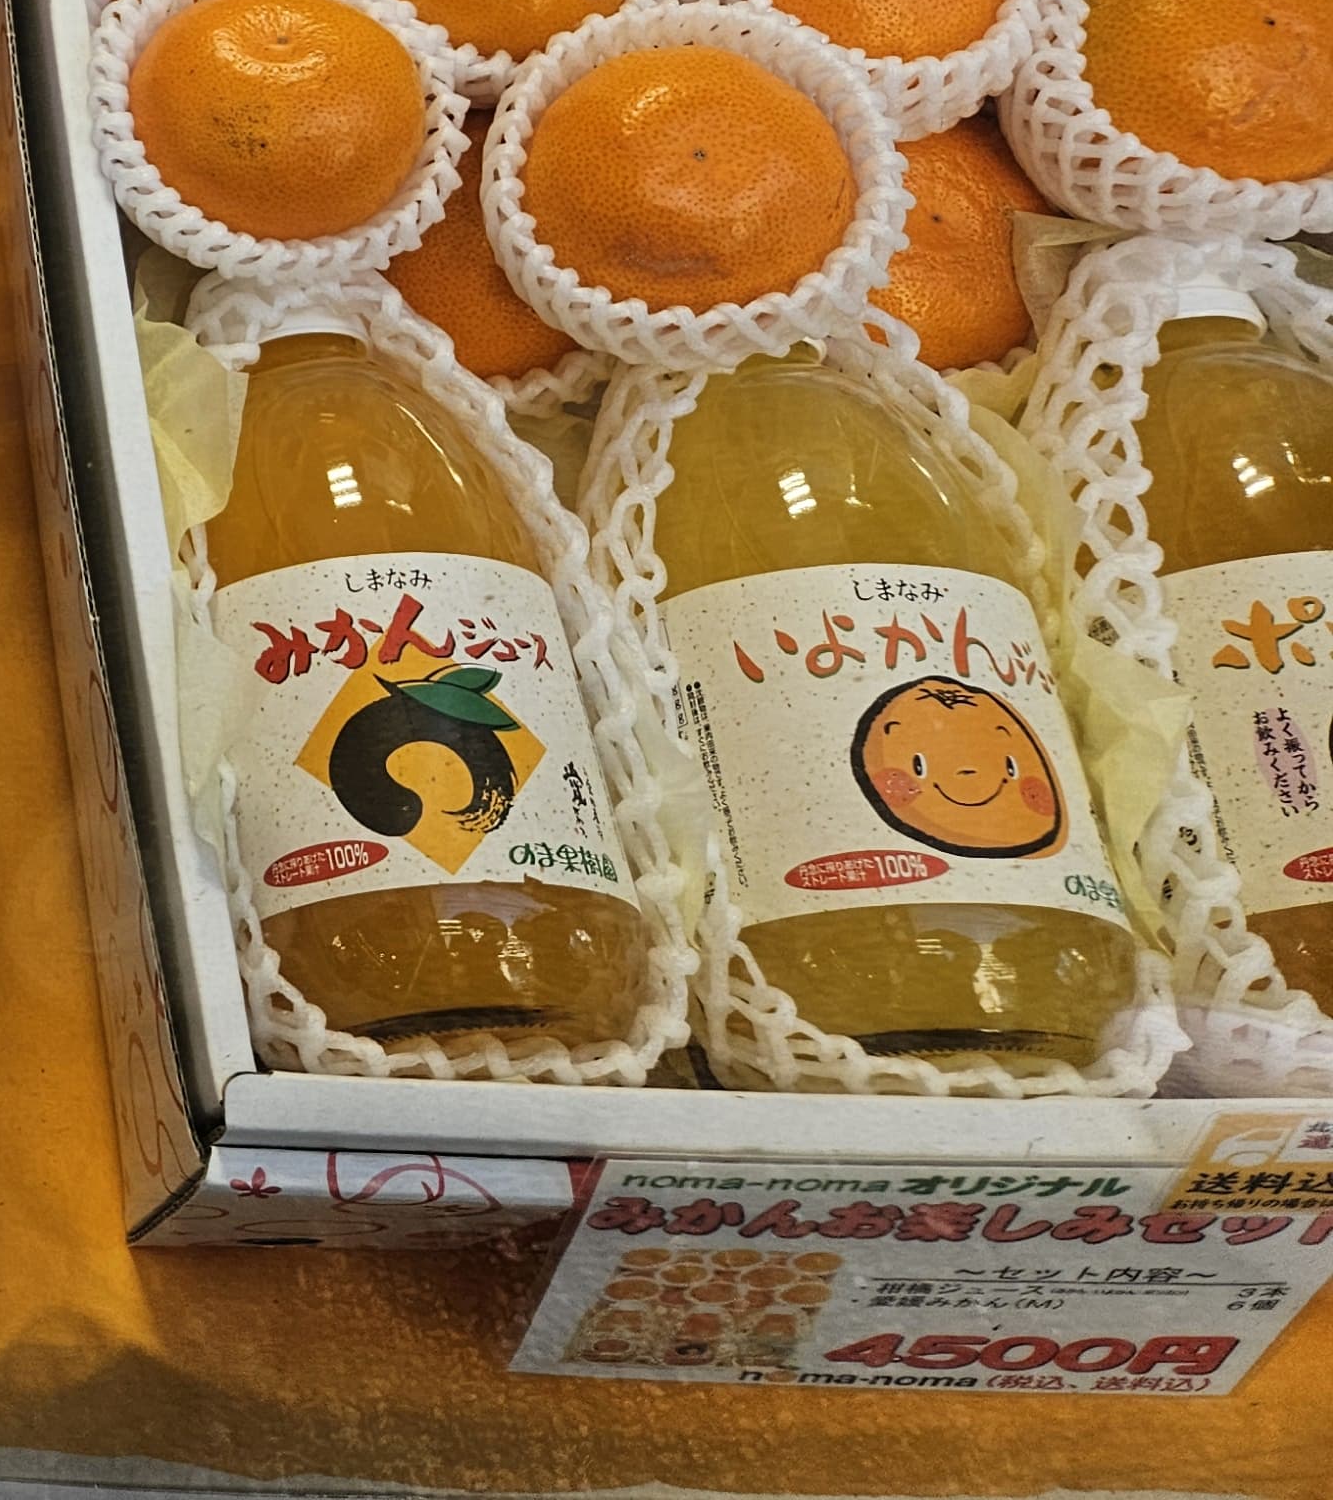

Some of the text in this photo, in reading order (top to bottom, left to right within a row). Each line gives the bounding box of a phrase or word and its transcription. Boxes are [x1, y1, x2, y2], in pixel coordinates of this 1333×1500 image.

[343, 568, 432, 594] しまなみ
[852, 578, 948, 603] しまなみ
[1212, 595, 1333, 675] ポ
[1252, 710, 1300, 819] お飲みください
[1275, 707, 1321, 813] よく振ってから
[325, 842, 369, 870] 100%
[508, 842, 619, 883] のま果樹園
[873, 853, 929, 879] 100%
[620, 1172, 1132, 1198] noma-noma オリジナル
[824, 1332, 1239, 1376] 4500円
